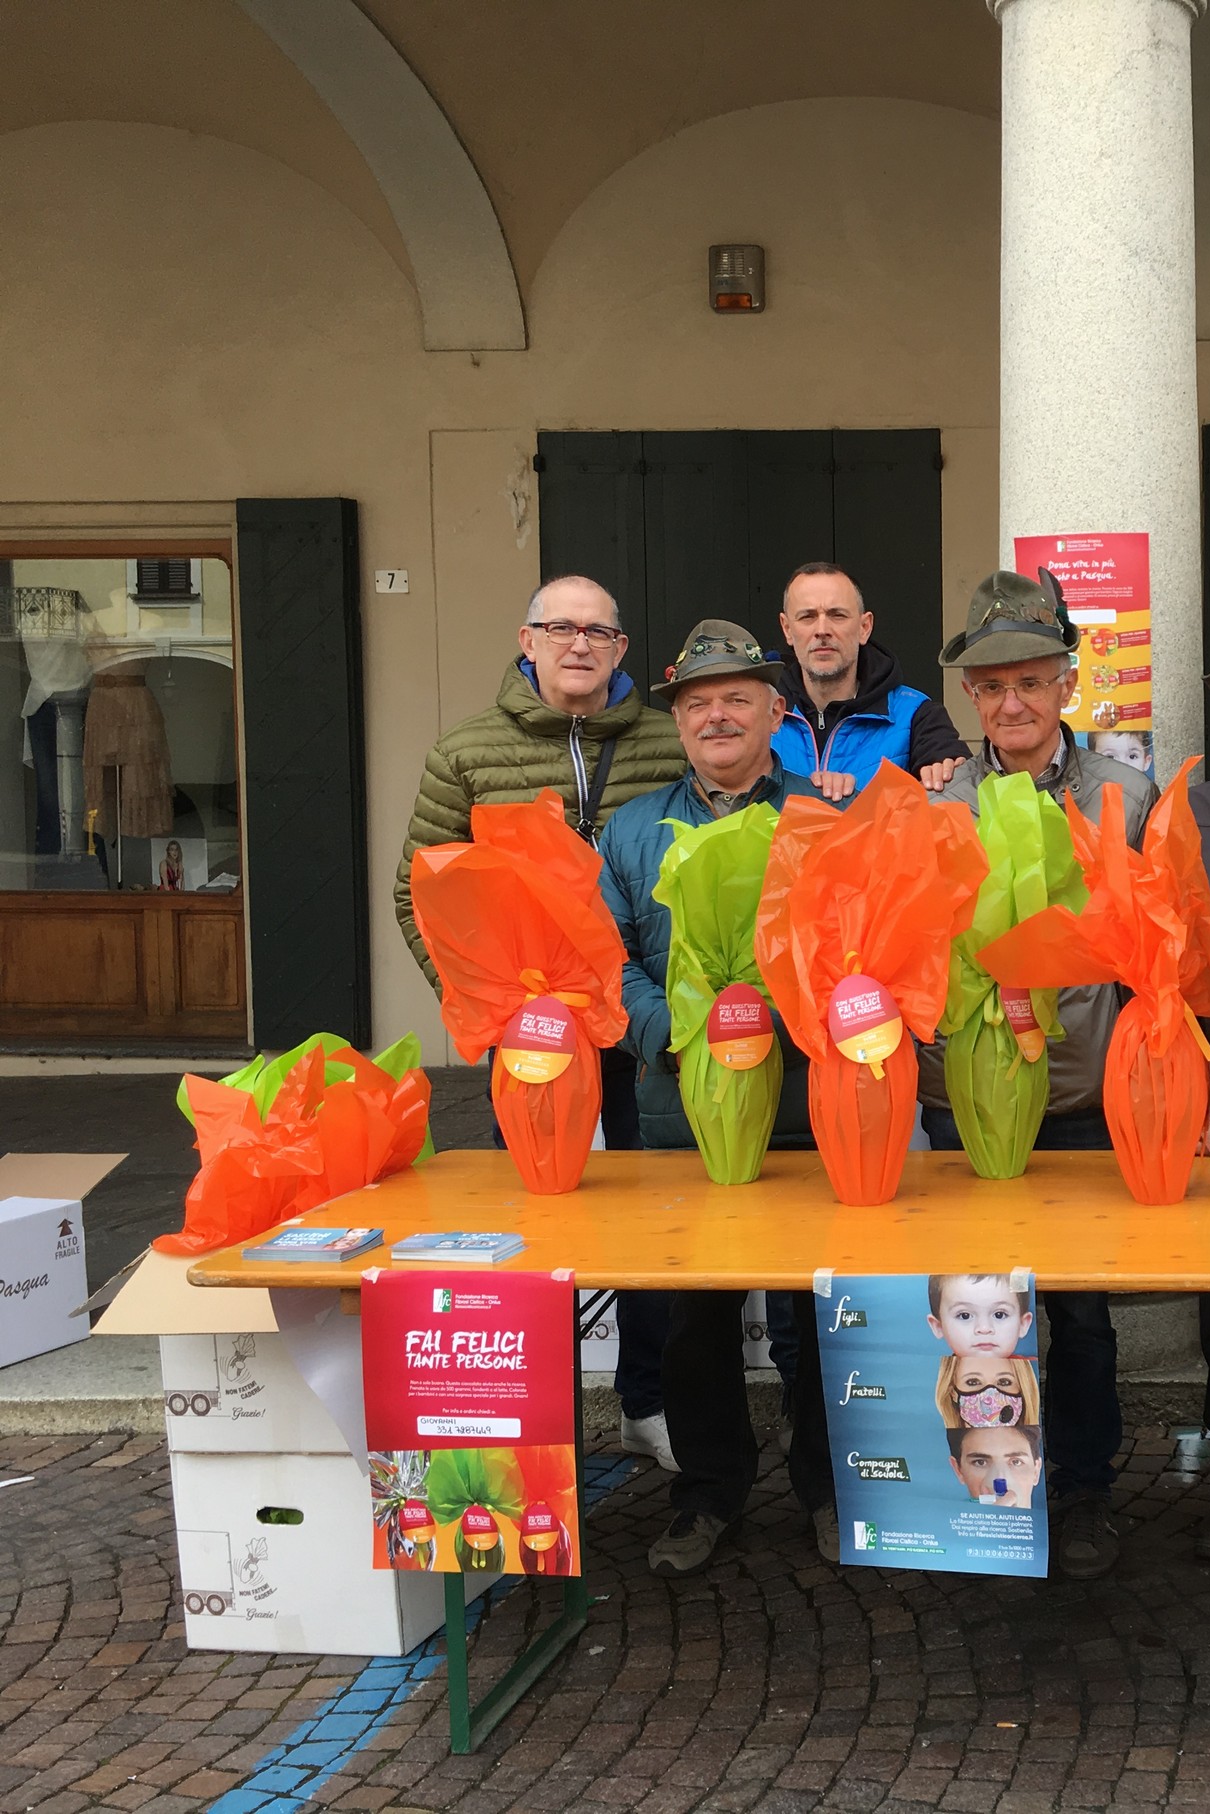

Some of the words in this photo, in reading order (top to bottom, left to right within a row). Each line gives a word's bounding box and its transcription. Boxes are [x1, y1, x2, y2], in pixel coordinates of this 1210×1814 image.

[388, 572, 395, 589] 7
[854, 996, 880, 1010] FELICI
[521, 1019, 536, 1028] FAI
[538, 1021, 565, 1034] FELICI
[57, 1236, 78, 1250] ALTO
[55, 1246, 80, 1260] FRAGILE
[828, 1296, 861, 1332] figli.
[405, 1330, 442, 1352] FAI
[451, 1330, 525, 1354] FELICI
[405, 1352, 452, 1370] TANTE
[456, 1353, 528, 1370] PERSONE.
[839, 1370, 885, 1406] fratelli.
[847, 1452, 900, 1472] Compagni
[860, 1468, 869, 1477] di
